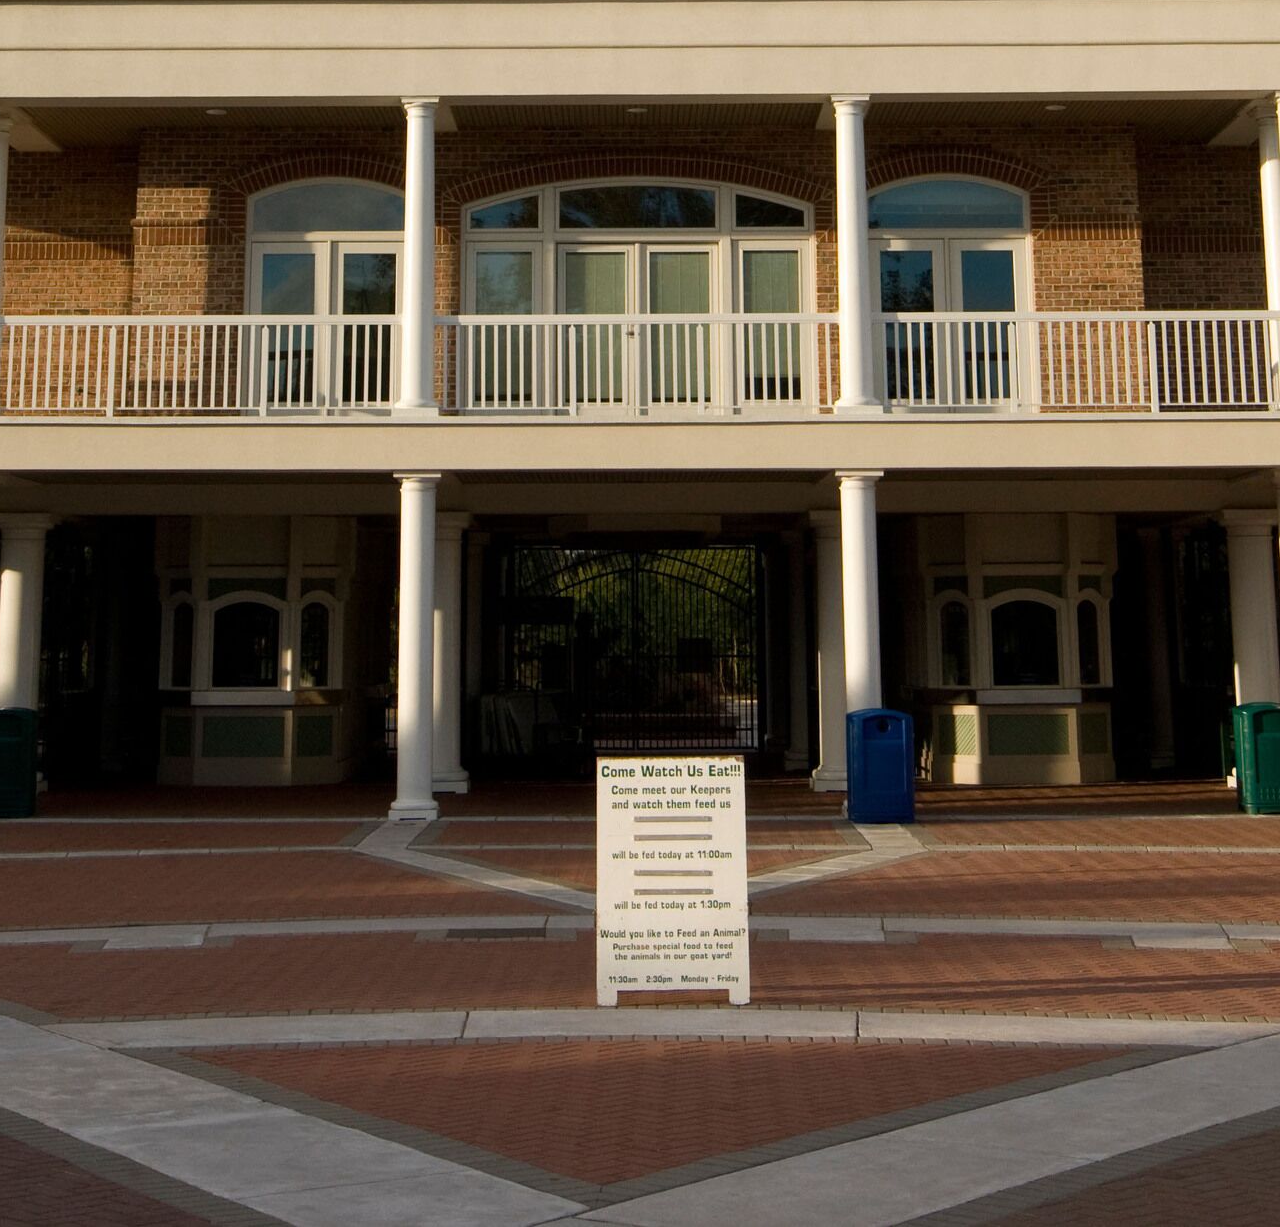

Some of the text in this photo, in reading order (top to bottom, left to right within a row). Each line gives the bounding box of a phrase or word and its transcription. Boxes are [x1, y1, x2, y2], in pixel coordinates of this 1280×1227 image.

[601, 765, 741, 777] Come Watch Us Eat!!!
[612, 786, 638, 795] Come
[642, 786, 666, 794] meet
[691, 785, 731, 796] Keepers
[612, 800, 628, 809] and
[633, 800, 662, 809] watch
[666, 800, 690, 809] them
[695, 799, 715, 808] feed
[612, 851, 626, 859] will
[629, 851, 638, 859] be
[642, 851, 655, 859] fed
[658, 851, 681, 860] today
[614, 901, 628, 909] will
[632, 901, 641, 909] be
[645, 901, 658, 909] fed
[661, 901, 684, 910] today
[688, 901, 696, 909] at
[600, 930, 626, 938] Would
[630, 931, 644, 939] you
[647, 929, 661, 937] like
[677, 929, 696, 937] Feed
[713, 929, 746, 937] Animal?
[653, 943, 680, 951] special
[691, 953, 708, 961] goat
[681, 975, 708, 983] Monday
[718, 975, 739, 983] Friday
